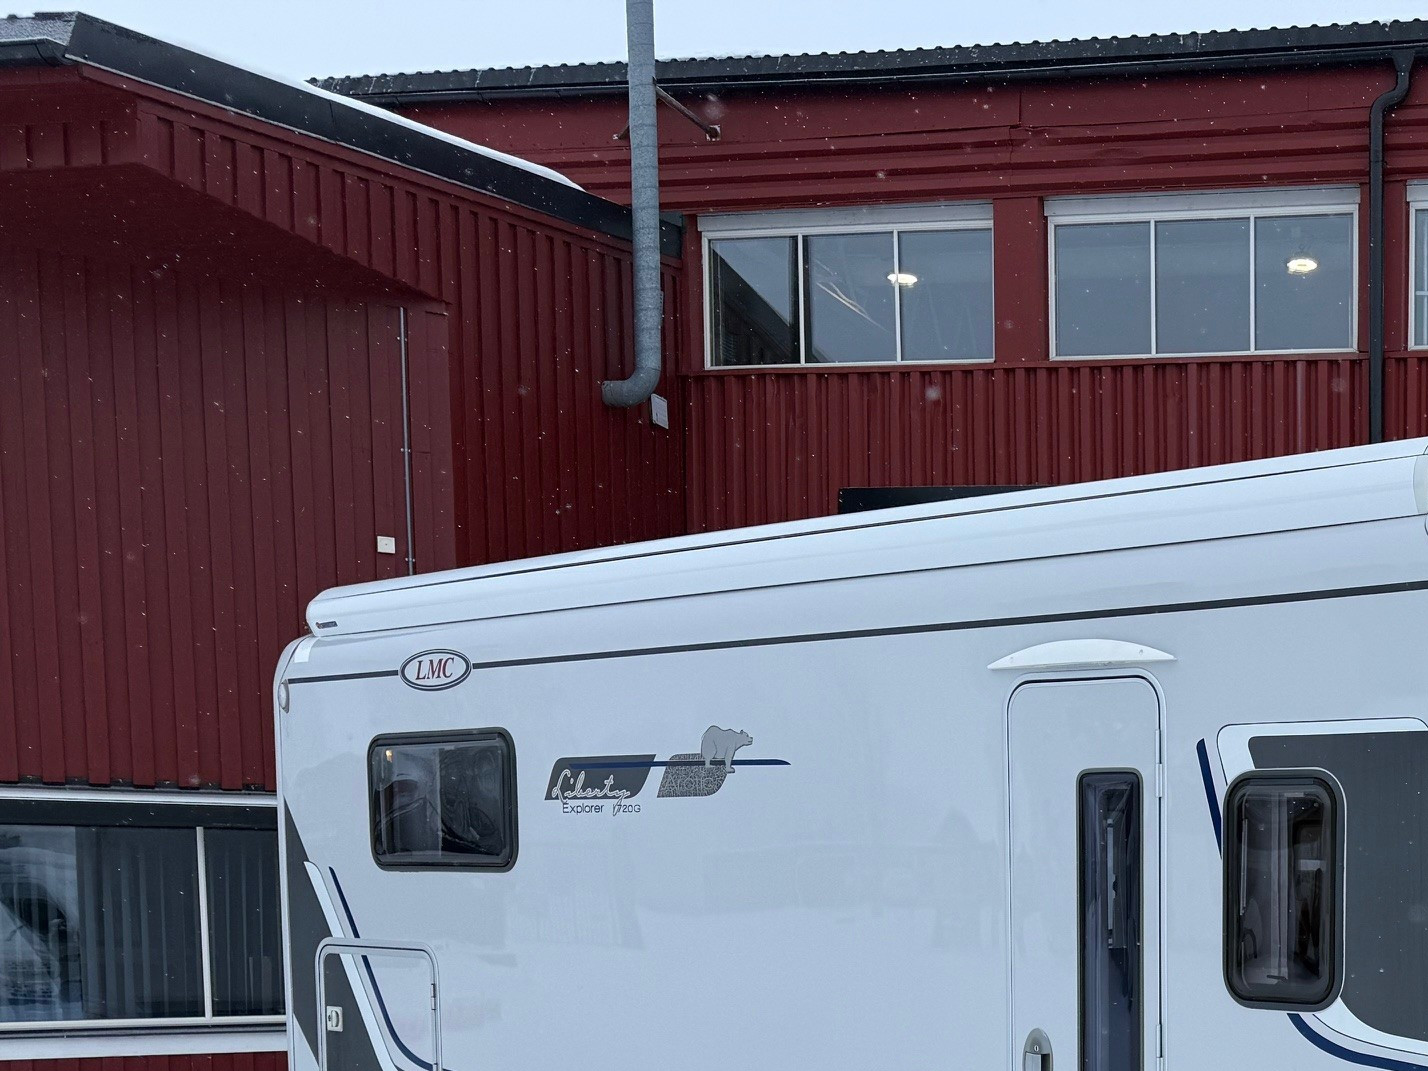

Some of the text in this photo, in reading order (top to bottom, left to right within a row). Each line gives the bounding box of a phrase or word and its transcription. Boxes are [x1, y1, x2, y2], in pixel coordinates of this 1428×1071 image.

[415, 656, 454, 680] LMC
[551, 768, 631, 817] Liberty
[562, 802, 605, 815] Explorer
